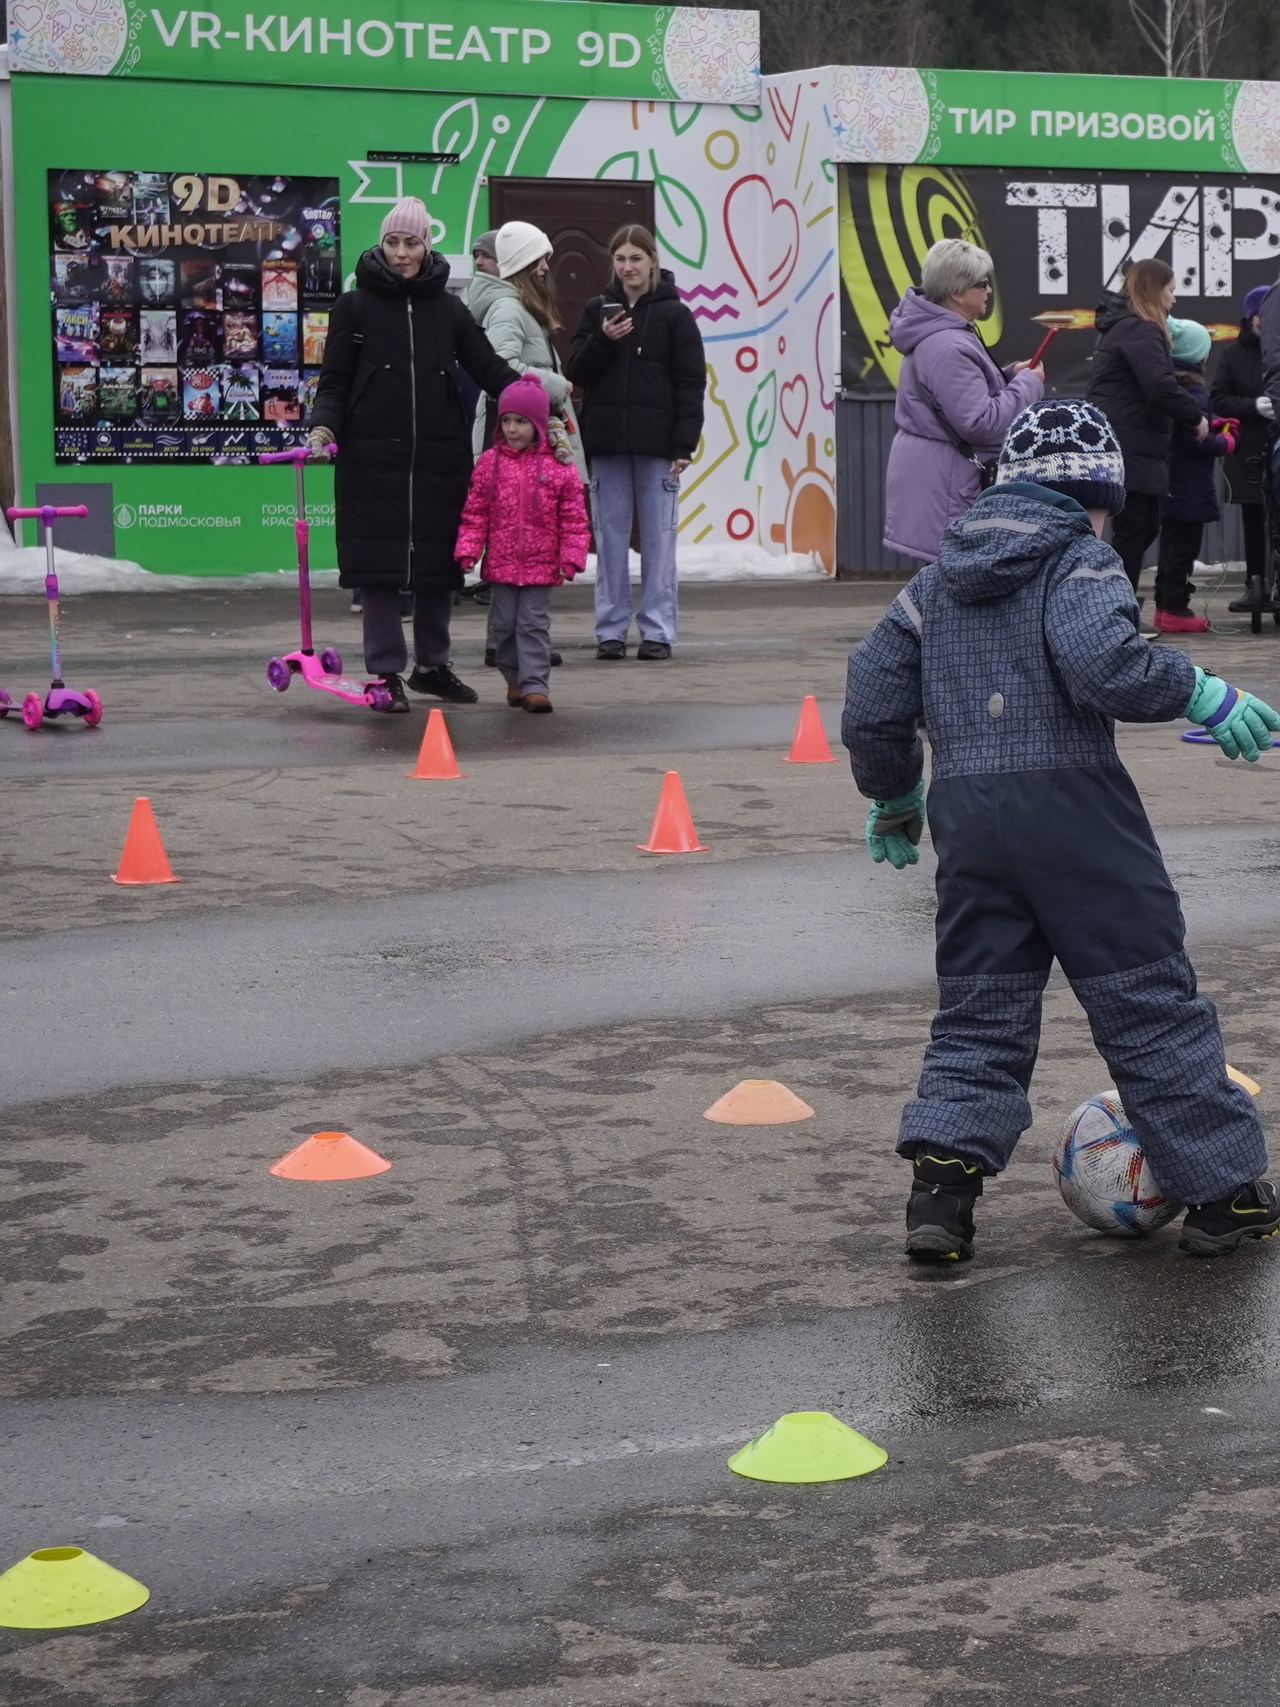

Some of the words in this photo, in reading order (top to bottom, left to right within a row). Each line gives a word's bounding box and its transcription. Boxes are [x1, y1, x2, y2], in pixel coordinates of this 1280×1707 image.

[151, 9, 552, 65] VR-КИНОТЕАТР
[577, 30, 643, 69] 9D
[949, 107, 1017, 135] ТИР
[1031, 108, 1216, 141] ПРИЗОВОЙ
[172, 175, 242, 213] 9D
[110, 222, 285, 249] КИНОТЕАТР
[138, 504, 183, 516] ПАРКИ
[138, 515, 242, 528] ПОДМОСКОВЬЯ
[262, 502, 336, 515] ГОРОСКОЙ
